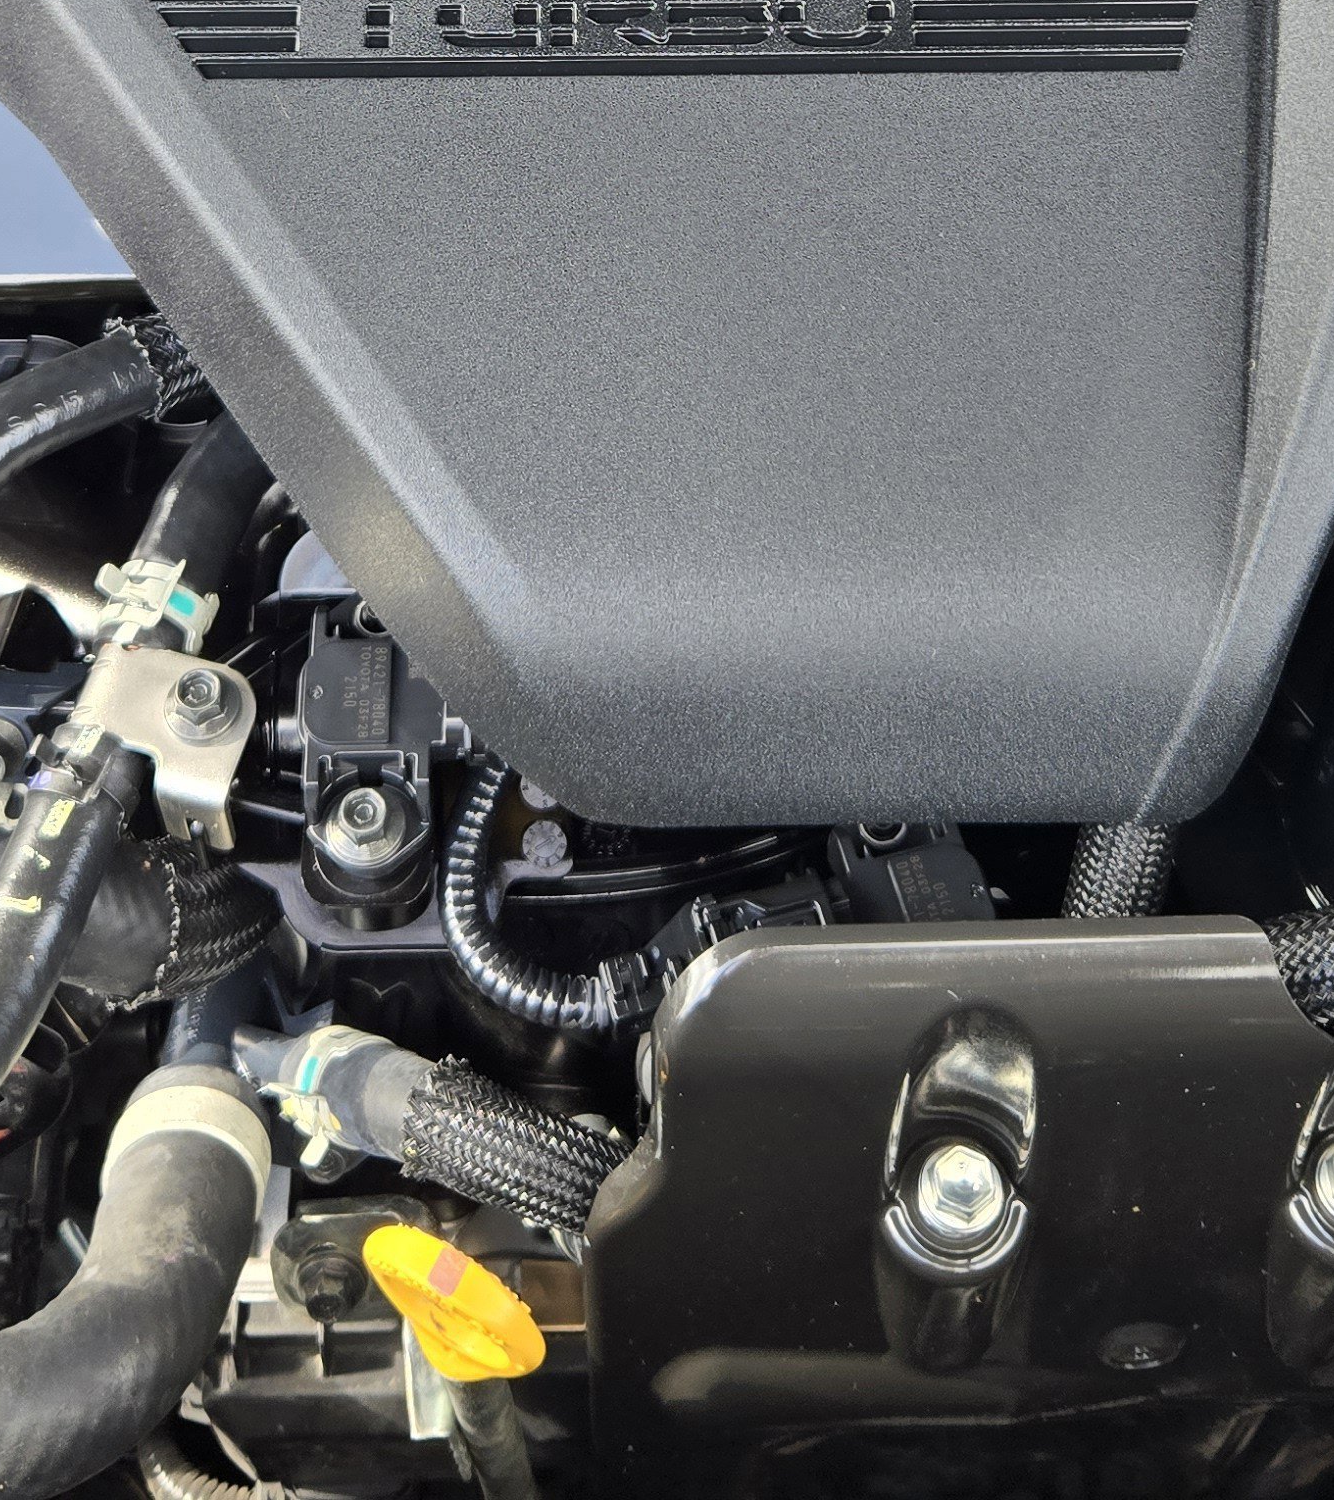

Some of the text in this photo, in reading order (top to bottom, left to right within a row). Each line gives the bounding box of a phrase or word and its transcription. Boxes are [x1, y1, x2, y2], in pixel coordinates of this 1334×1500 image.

[343, 676, 357, 707] 2150
[360, 646, 371, 691] TOYOTA
[371, 646, 387, 735] 89421-78040
[896, 861, 924, 916] 1-78040
